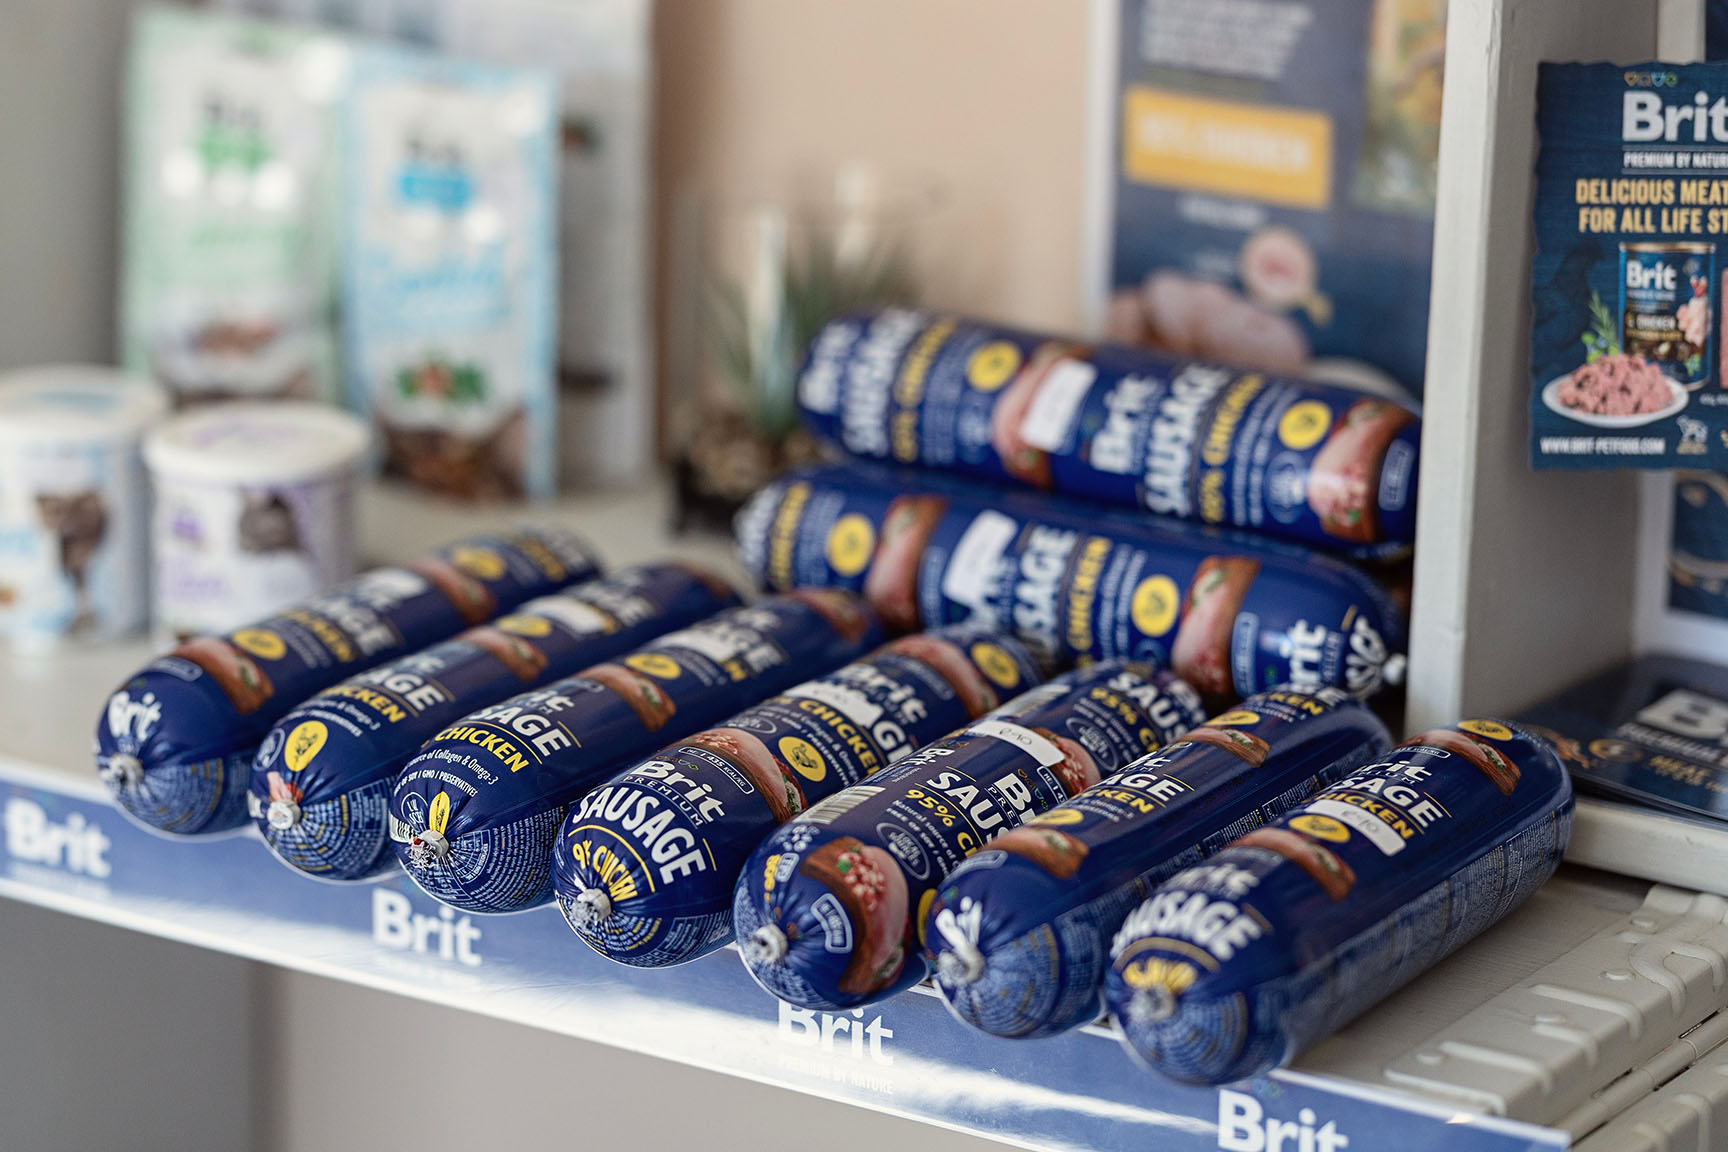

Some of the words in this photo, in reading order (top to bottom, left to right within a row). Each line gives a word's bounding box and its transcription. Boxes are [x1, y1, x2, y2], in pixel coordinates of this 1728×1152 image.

[1622, 90, 1728, 142] Brit
[1623, 152, 1675, 169] PREMIUM
[1676, 152, 1691, 168] BY
[1575, 178, 1675, 205] DELICIOUS
[1578, 206, 1617, 233] FOR
[1620, 207, 1656, 233] ALL
[1661, 208, 1702, 233] LIFE
[1626, 259, 1677, 290] Brit
[433, 726, 530, 774] CHICKEN
[434, 749, 463, 764] Collagen
[462, 755, 470, 766] &
[468, 758, 499, 786] Omega-3
[706, 754, 725, 769] 435
[723, 766, 746, 788] KCAL/KG
[1360, 760, 1433, 783] rit
[422, 770, 436, 779] GMO
[630, 760, 725, 823] Brit
[623, 775, 703, 827] PREMIUM
[892, 799, 927, 824] Natural
[926, 820, 949, 849] source
[904, 788, 957, 828] 95%
[6, 797, 111, 878] Brit
[572, 786, 707, 885] SAUSAGE
[373, 888, 482, 966] Brit
[778, 998, 894, 1066] Brit
[1217, 1088, 1349, 1152] Brit
